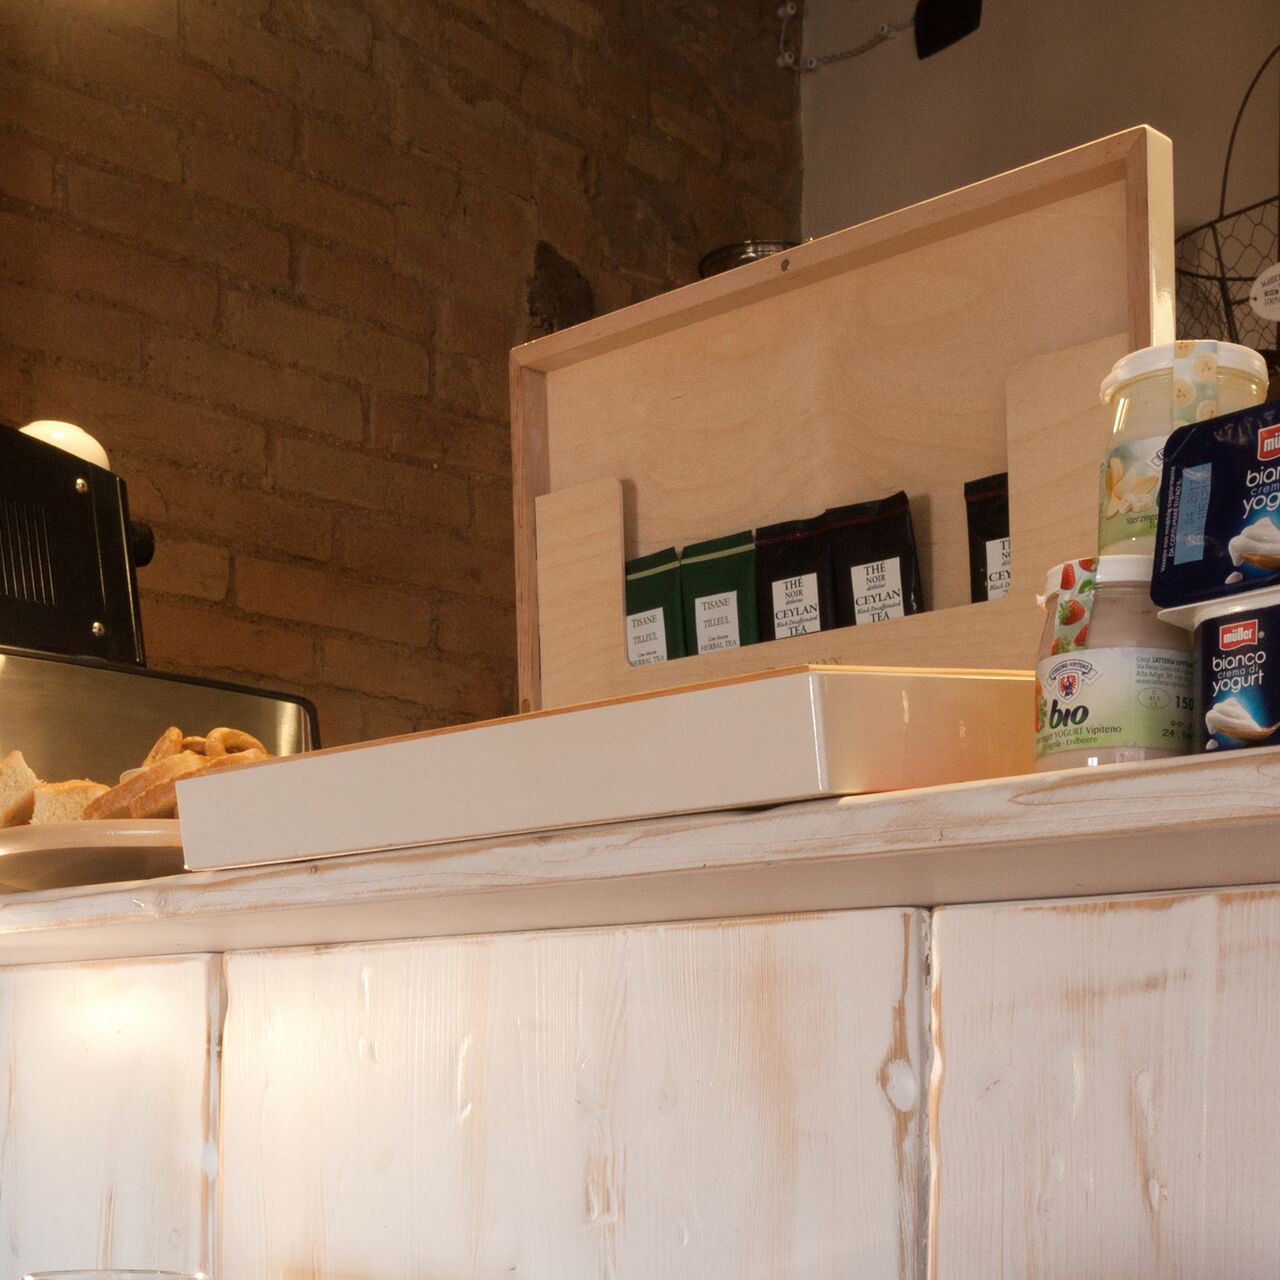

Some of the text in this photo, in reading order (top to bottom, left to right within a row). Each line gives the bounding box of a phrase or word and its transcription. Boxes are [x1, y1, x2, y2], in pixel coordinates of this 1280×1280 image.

[866, 574, 886, 585] NOIR
[785, 589, 804, 600] NOIR
[855, 588, 901, 607] CEYLAN
[701, 598, 730, 612] TISANE
[775, 603, 818, 621] CEYLAN
[631, 614, 657, 629] TISANE
[870, 611, 890, 624] TEA
[787, 625, 807, 637] TEA
[1223, 625, 1253, 644] müller
[725, 639, 738, 648] TEA
[1212, 651, 1266, 672] bianco
[1217, 663, 1259, 679] crema di
[1212, 669, 1265, 698] yogurt
[1049, 699, 1090, 729] bio
[1085, 726, 1122, 736] Vipiteno
